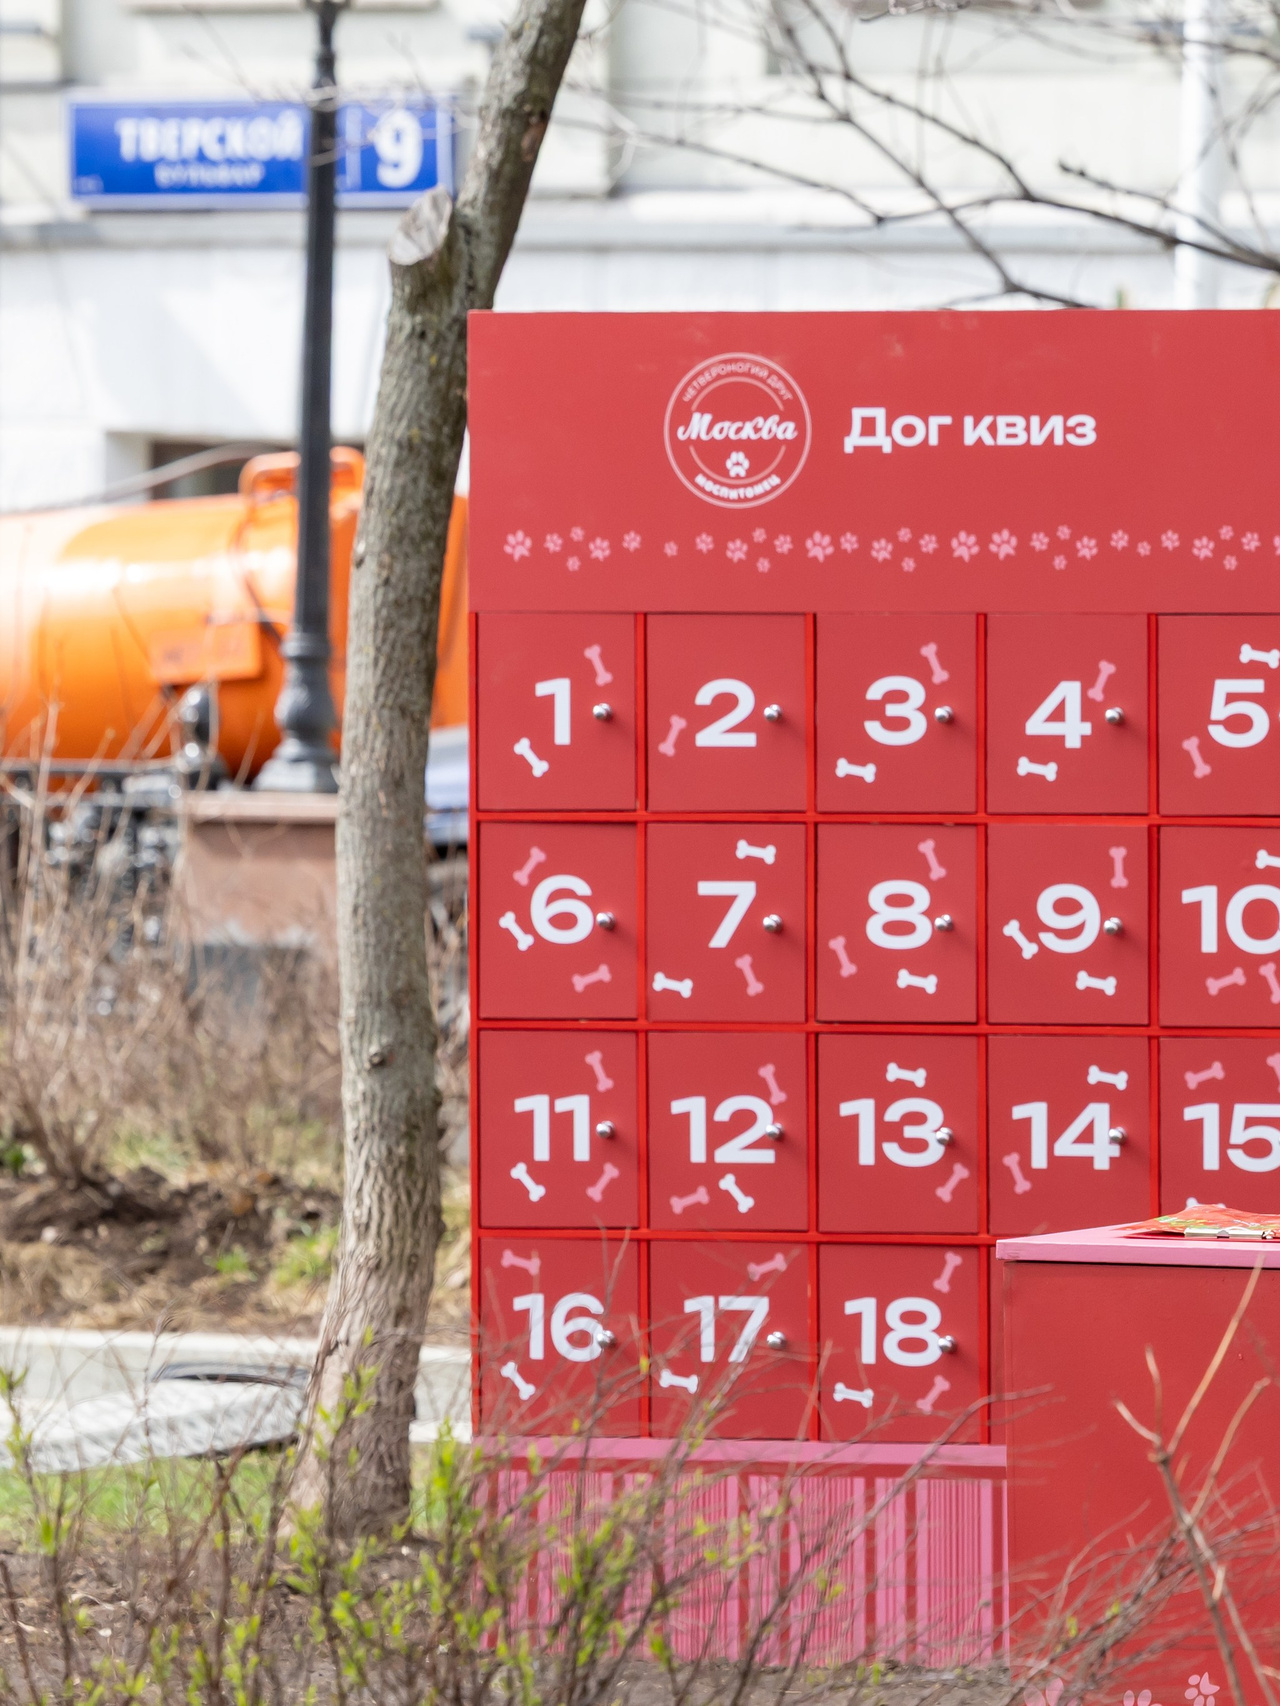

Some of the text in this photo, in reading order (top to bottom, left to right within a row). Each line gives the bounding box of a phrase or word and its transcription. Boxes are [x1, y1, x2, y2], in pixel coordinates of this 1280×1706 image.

[115, 108, 304, 162] ТВЕРСКОЙ
[374, 108, 423, 188] 9
[682, 361, 794, 402] ЧЕТВЕРОНОГИЙ ДРУГ
[677, 411, 798, 441] Москва
[844, 407, 1097, 453] Дог квиз
[694, 473, 782, 500] МОСПИТОМЕЦ
[535, 678, 571, 745] 1
[694, 678, 757, 747] 2
[863, 675, 927, 746] 3
[1025, 680, 1092, 749] 4
[1207, 679, 1270, 748] 5
[530, 874, 594, 944] 6
[697, 881, 757, 948] 7
[865, 879, 933, 950] 8
[1036, 883, 1101, 954] 9
[514, 1094, 590, 1162] 11
[670, 1094, 776, 1164] 12
[839, 1097, 946, 1167] 13
[1012, 1101, 1121, 1170] 14
[513, 1292, 605, 1363] 16
[683, 1295, 770, 1363] 17
[844, 1296, 943, 1367] 18
